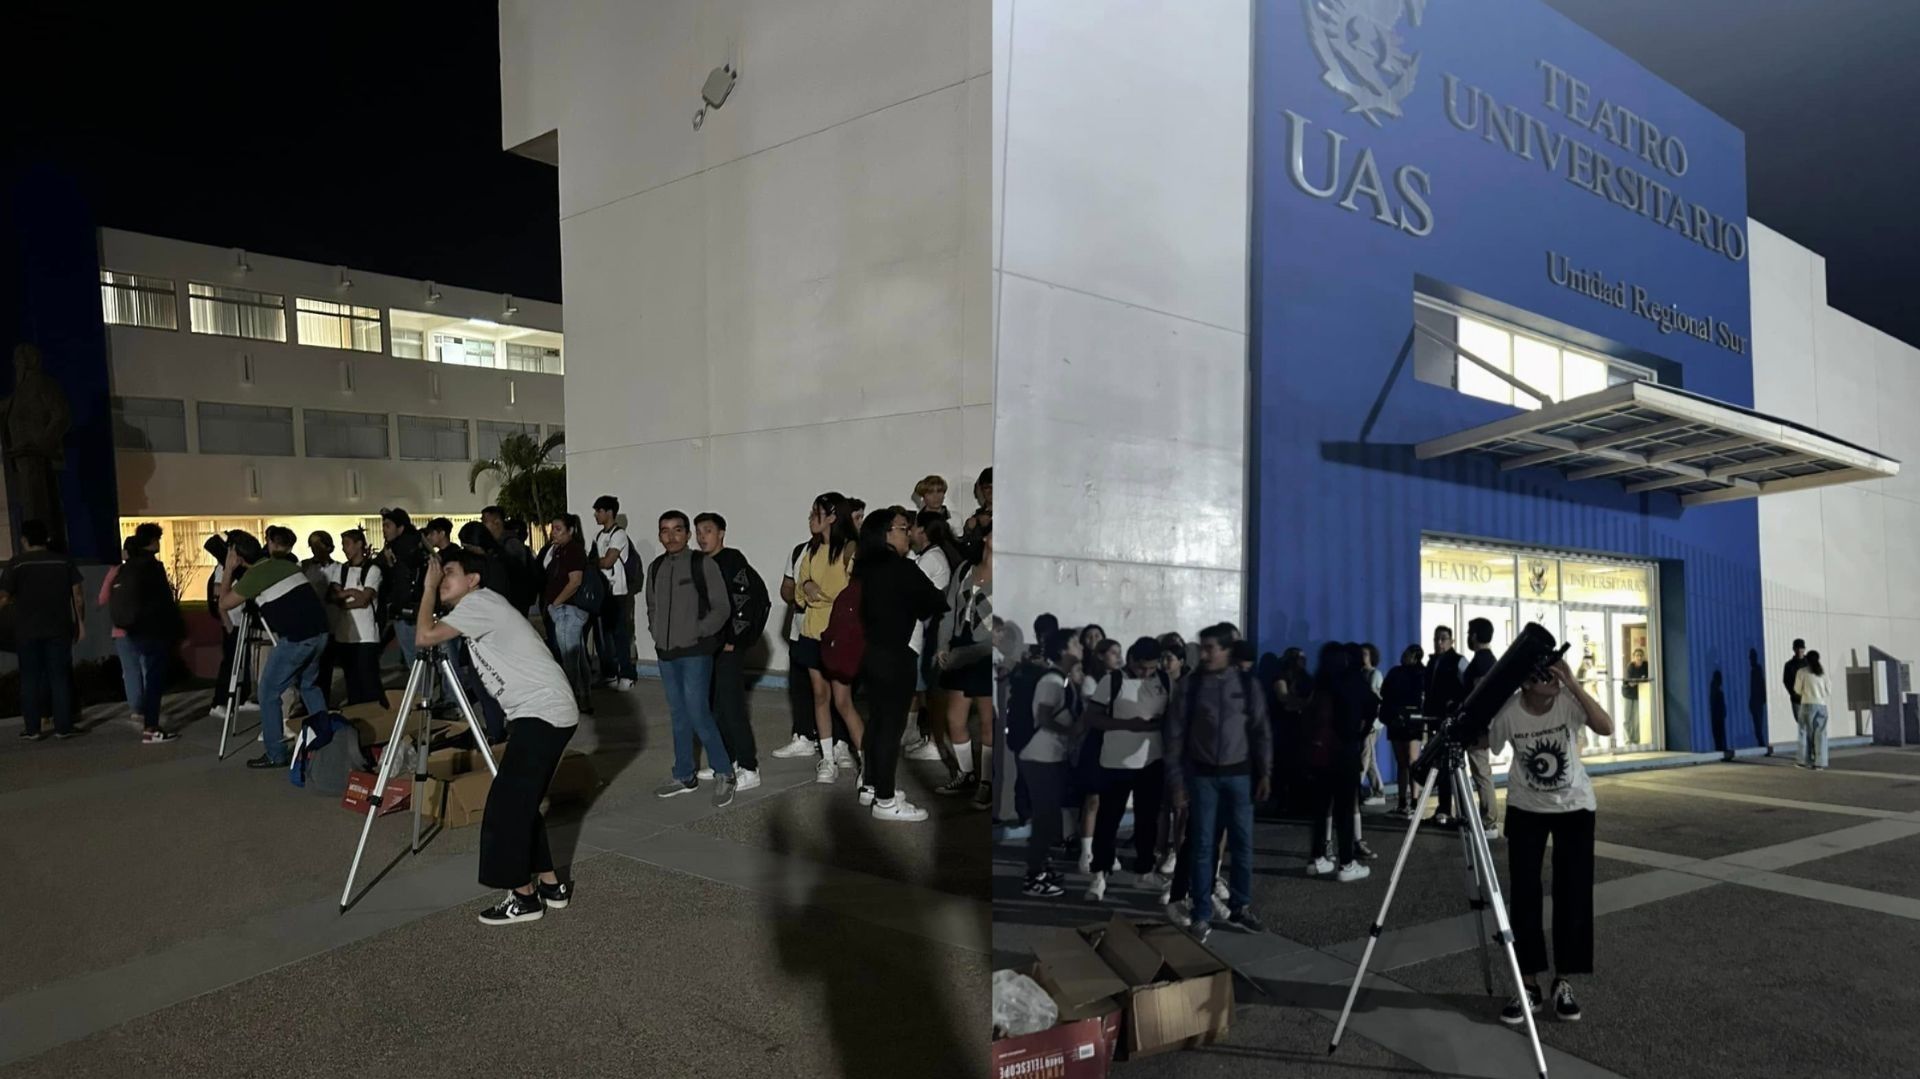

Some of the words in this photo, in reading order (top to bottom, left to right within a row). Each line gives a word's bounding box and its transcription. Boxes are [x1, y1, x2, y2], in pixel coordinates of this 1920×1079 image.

[1281, 109, 1434, 237] UAS
[1442, 72, 1746, 262] UNIVERSITARIO
[1537, 59, 1689, 178] TEATRO
[1546, 250, 1627, 311] Unidad
[1630, 284, 1713, 343] Regional
[1715, 321, 1747, 355] Sur
[1427, 560, 1492, 584] TEATRO
[999, 1056, 1045, 1079] TELESCOPE
